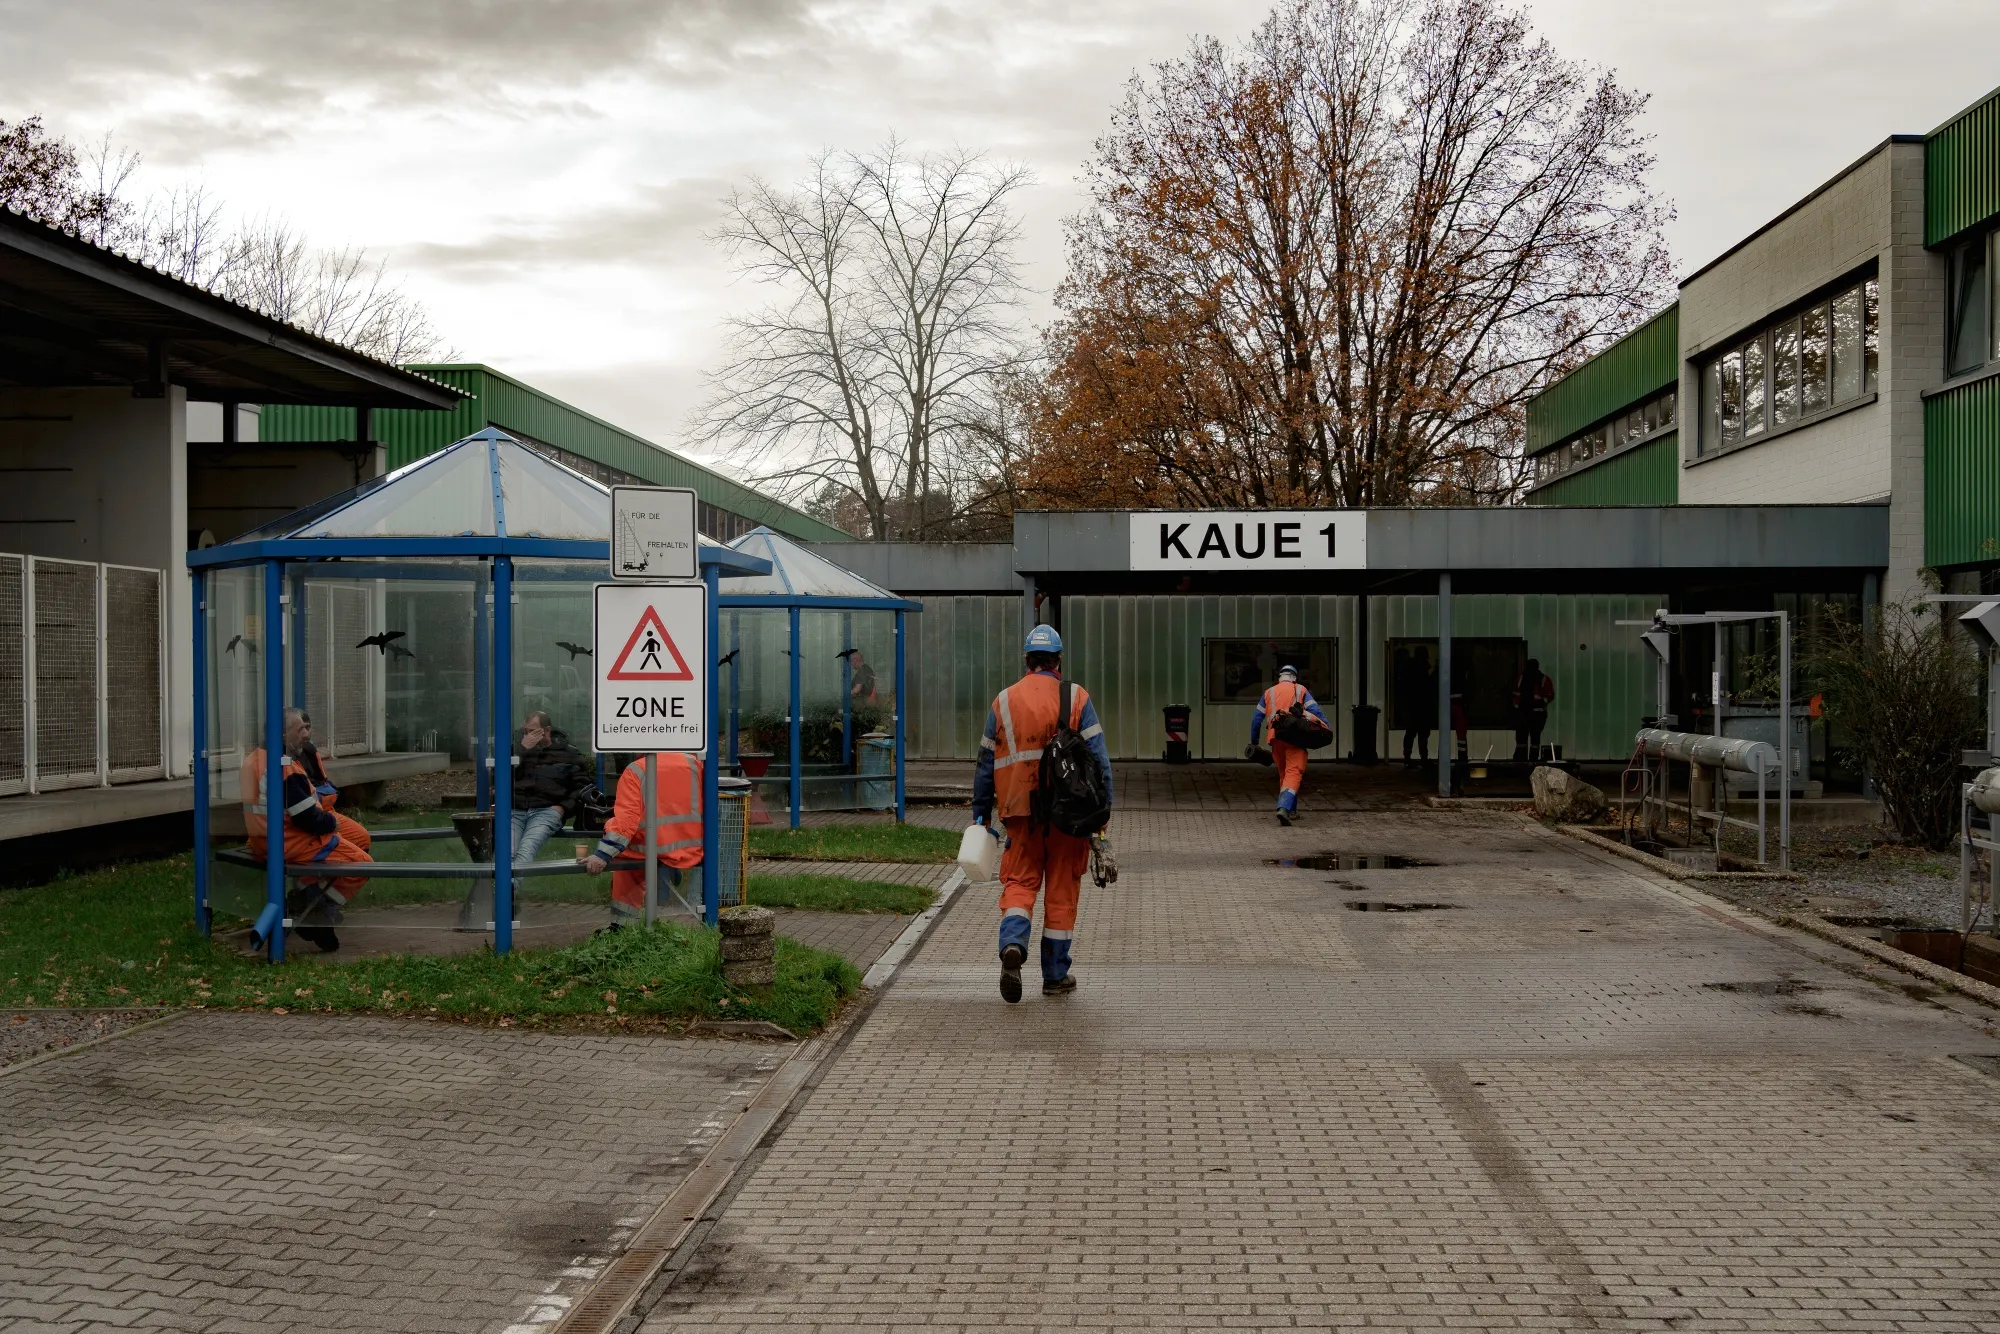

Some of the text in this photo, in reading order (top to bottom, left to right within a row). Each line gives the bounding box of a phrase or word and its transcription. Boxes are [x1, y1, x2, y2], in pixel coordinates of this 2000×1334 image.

[631, 511, 661, 520] FÜR DIE
[647, 541, 689, 549] FREIHALTEN
[1160, 522, 1336, 559] KAUE 1
[616, 696, 685, 718] ZONE
[602, 723, 699, 734] Lieferverkehr frei
